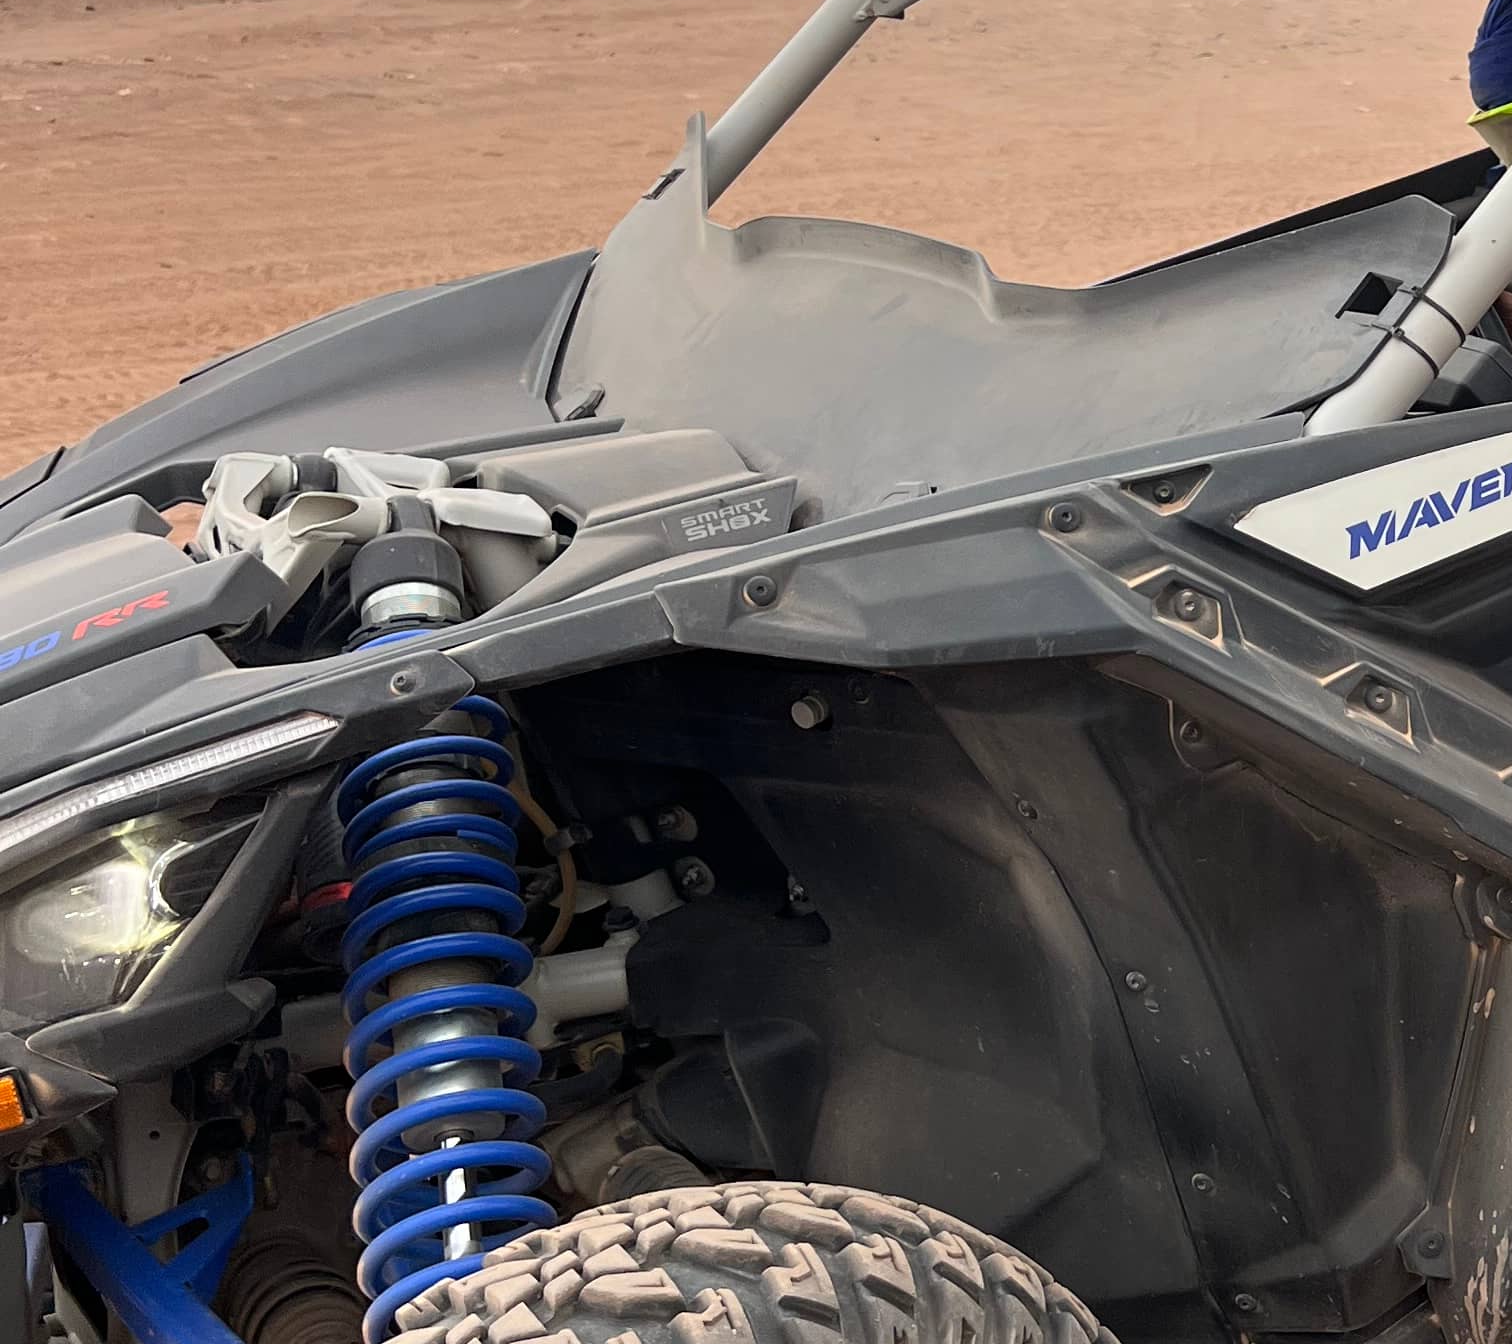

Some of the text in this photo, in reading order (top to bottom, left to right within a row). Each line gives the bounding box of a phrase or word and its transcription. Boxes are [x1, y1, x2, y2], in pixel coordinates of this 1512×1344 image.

[681, 498, 766, 529] SMART
[685, 508, 772, 542] SHOX
[72, 591, 169, 640] RR
